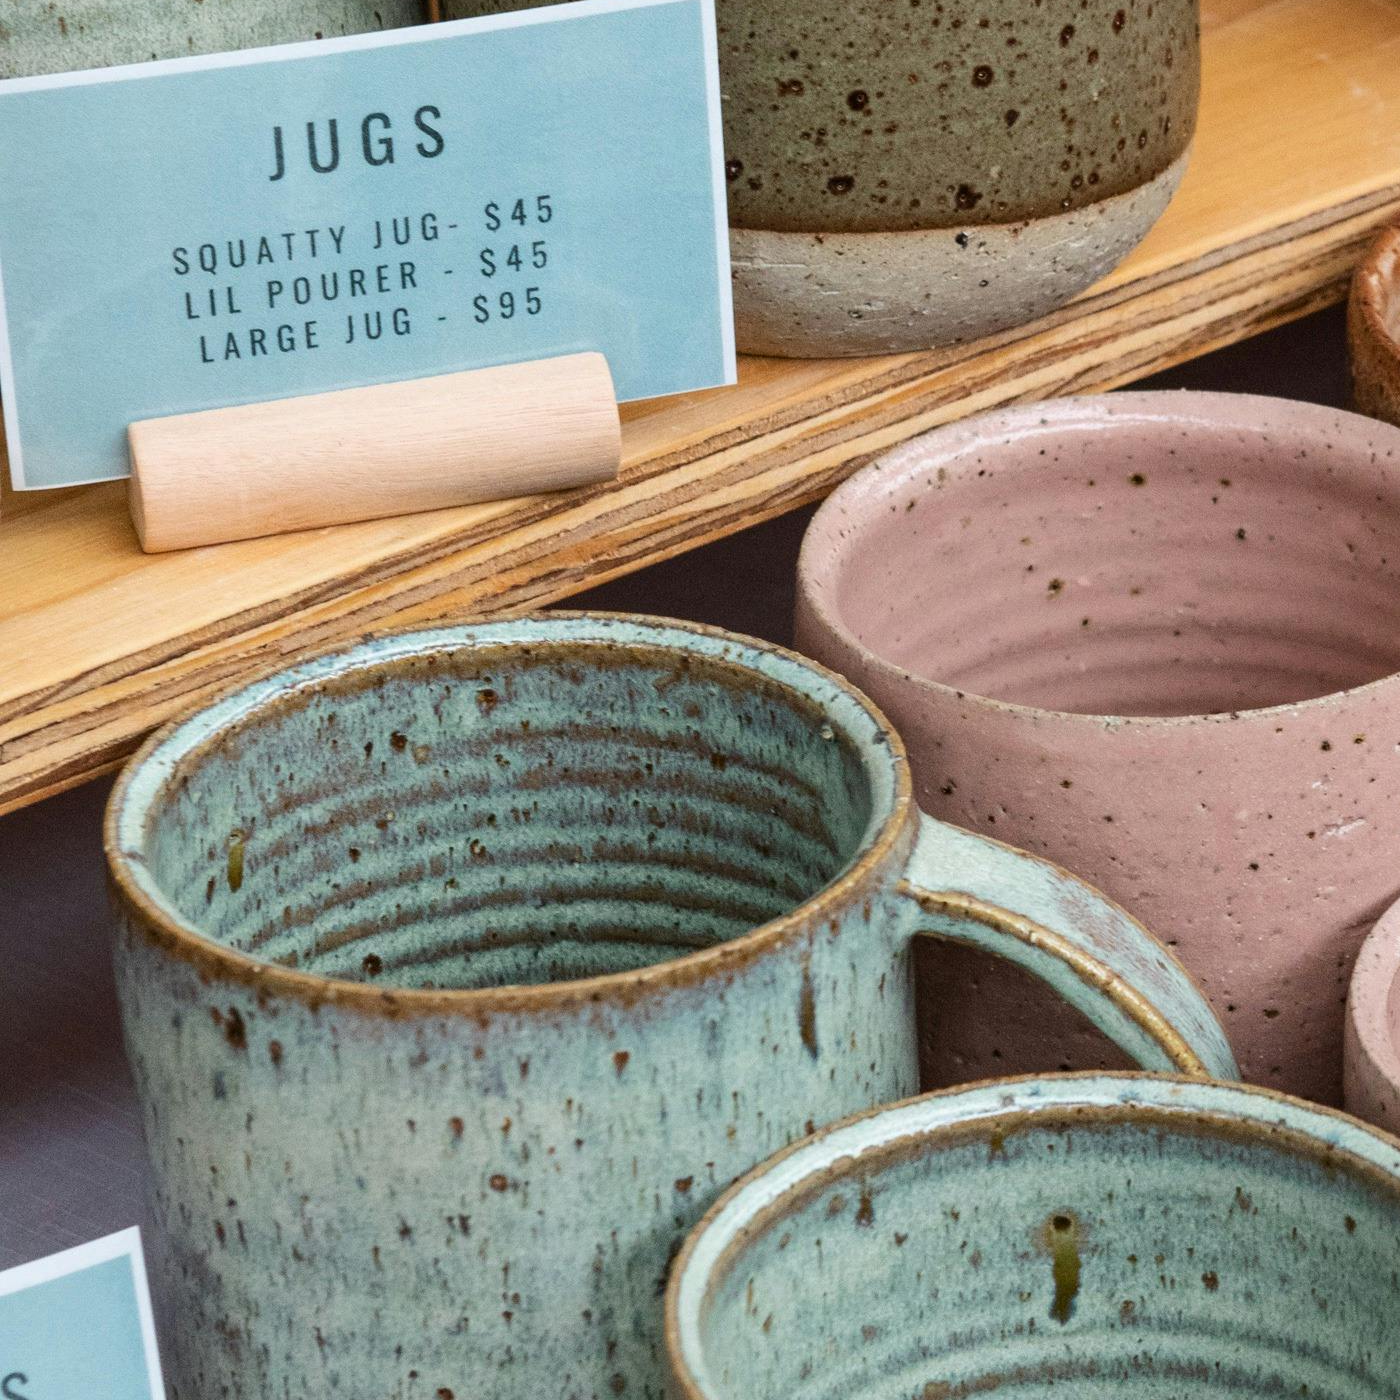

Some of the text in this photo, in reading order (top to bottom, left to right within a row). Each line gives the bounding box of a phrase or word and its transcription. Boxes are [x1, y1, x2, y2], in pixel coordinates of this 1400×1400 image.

[269, 105, 445, 181] JUGS
[172, 225, 345, 275] SQUATTY
[484, 195, 552, 232] $45
[185, 286, 241, 319] LIL
[267, 261, 417, 308] POURER
[479, 241, 548, 278] $45
[200, 321, 319, 363] LARGE
[345, 307, 411, 344] JUG
[472, 287, 542, 324] $95
